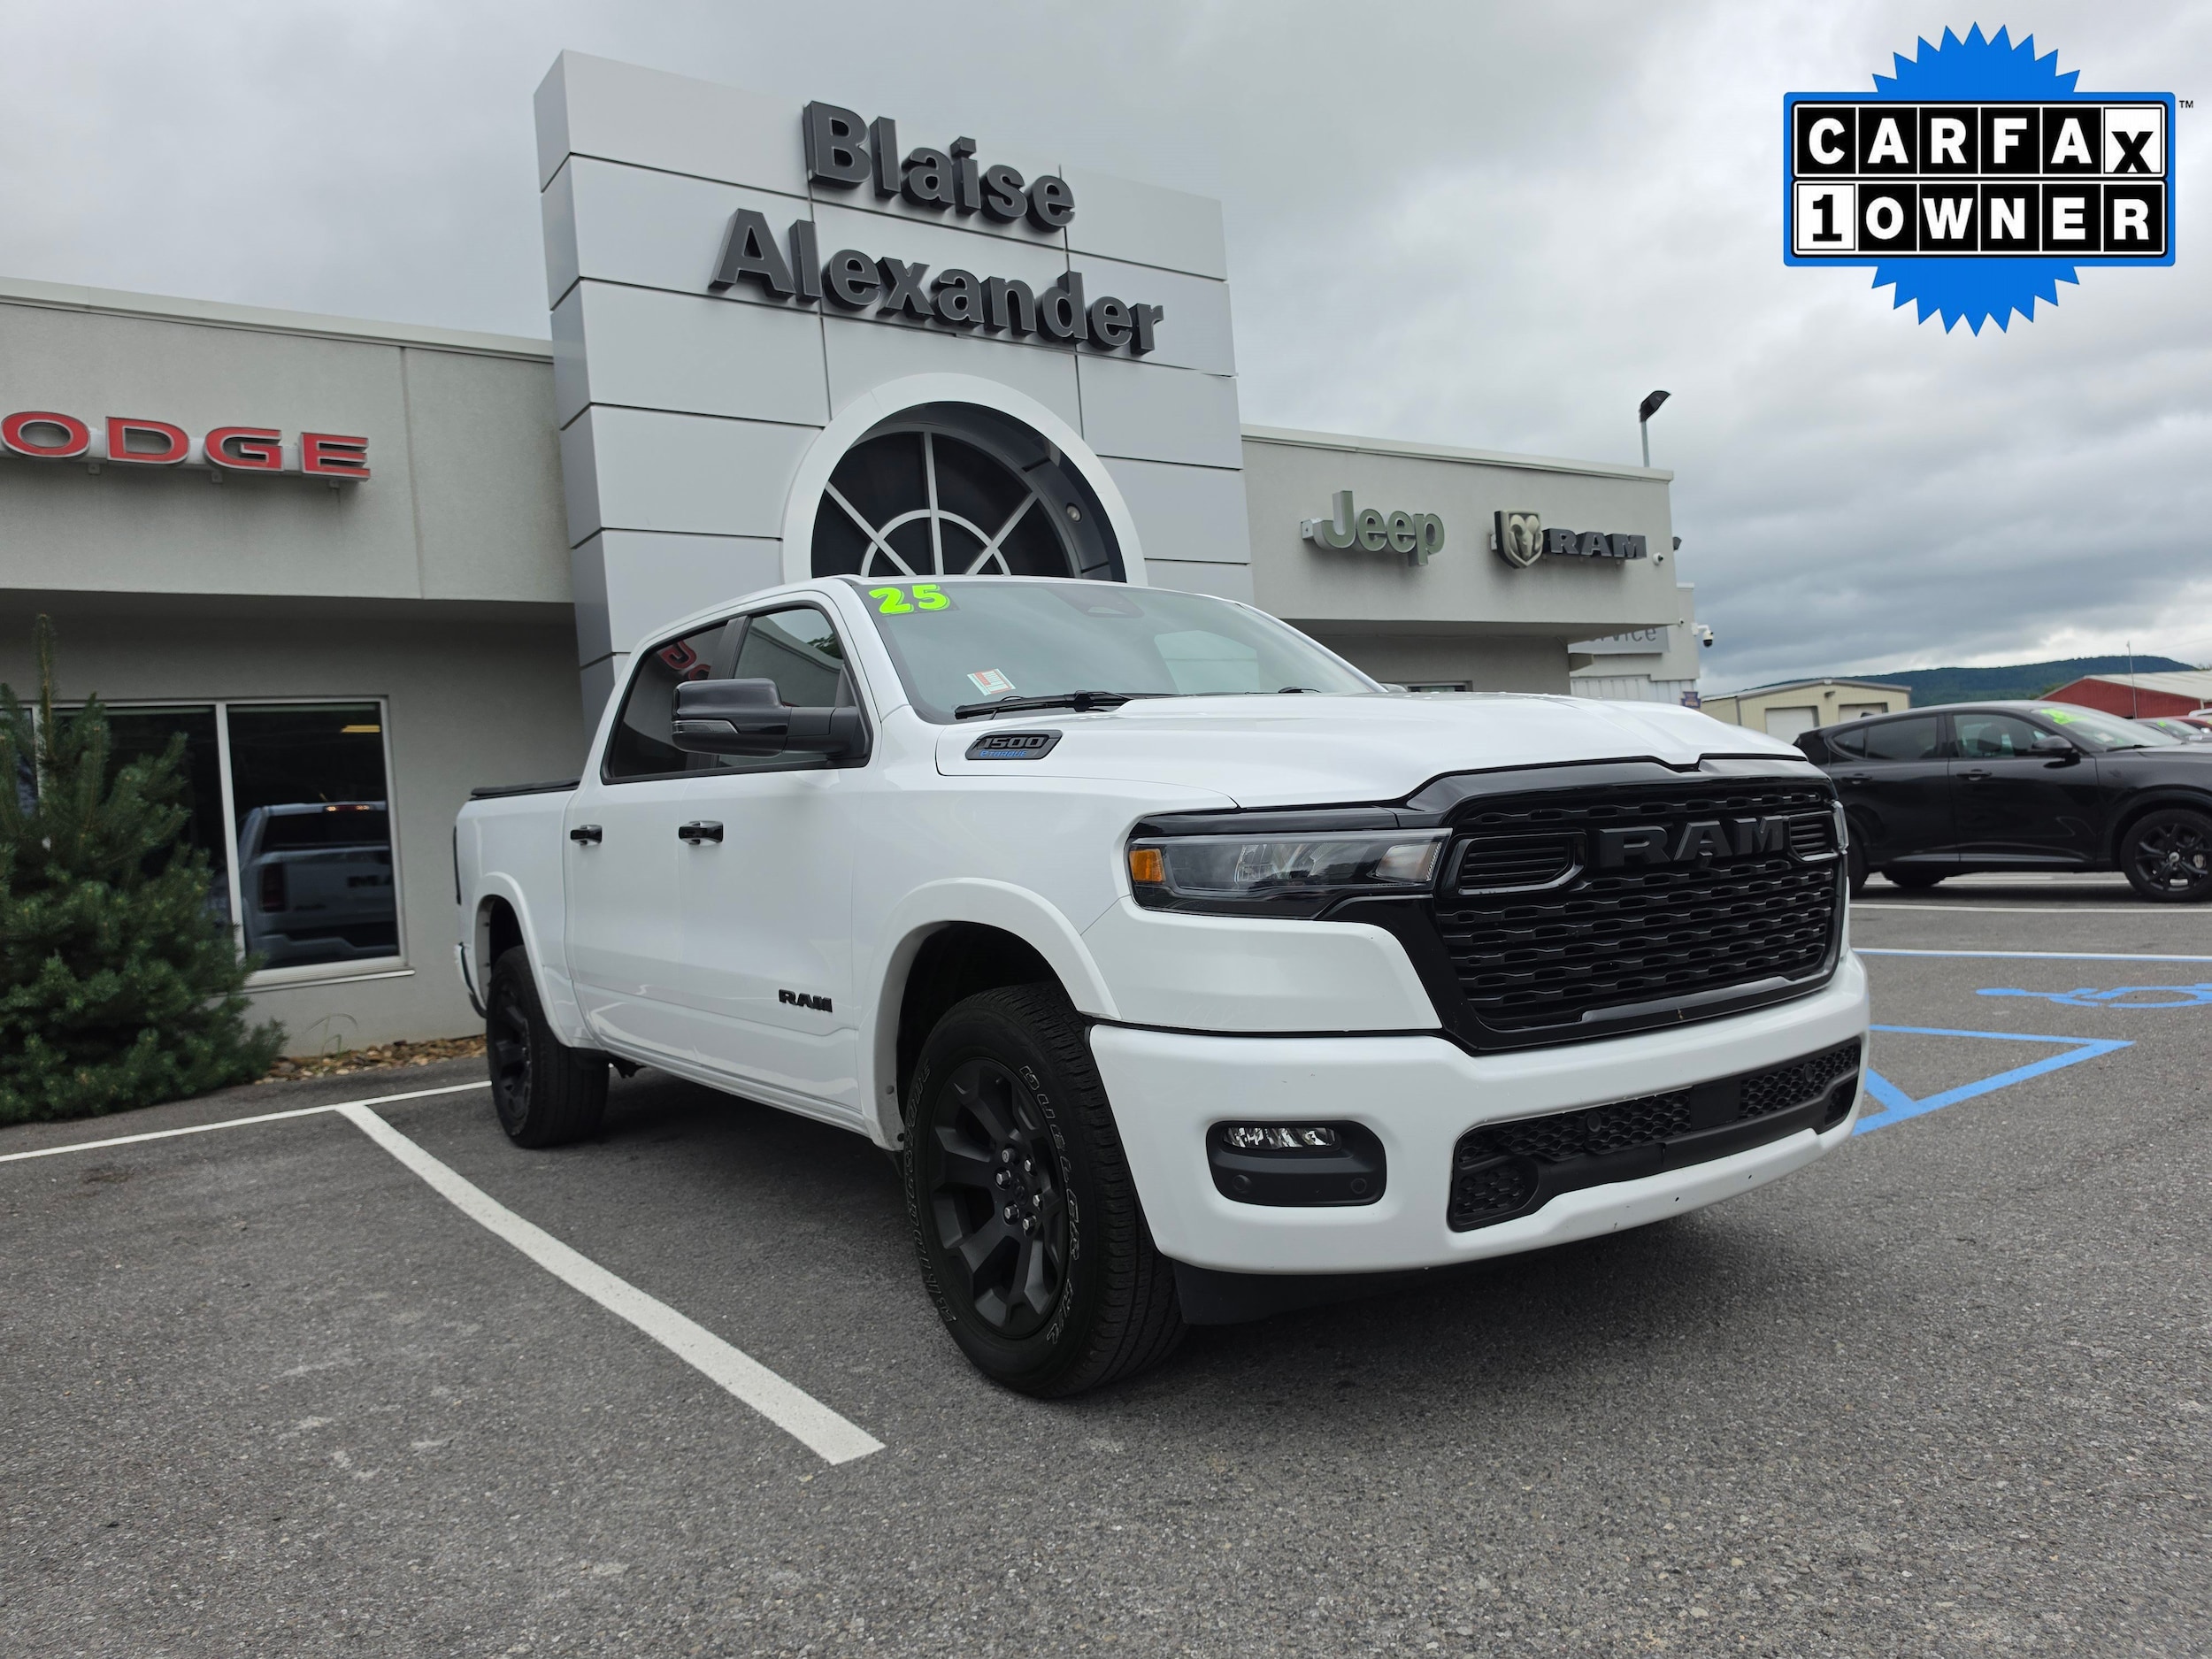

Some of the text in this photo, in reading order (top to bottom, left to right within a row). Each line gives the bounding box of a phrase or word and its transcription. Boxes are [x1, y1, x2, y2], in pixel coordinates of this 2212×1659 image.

[804, 100, 1075, 233] Blaise
[708, 208, 1164, 356] Alexander
[1313, 490, 1445, 566] Jeep
[1544, 528, 1647, 559] RAM
[868, 584, 950, 616] 25
[982, 736, 1046, 749] 1500
[1600, 815, 1784, 868] RAM
[779, 988, 833, 1013] RAM
[1018, 1064, 1079, 1261] DUELER
